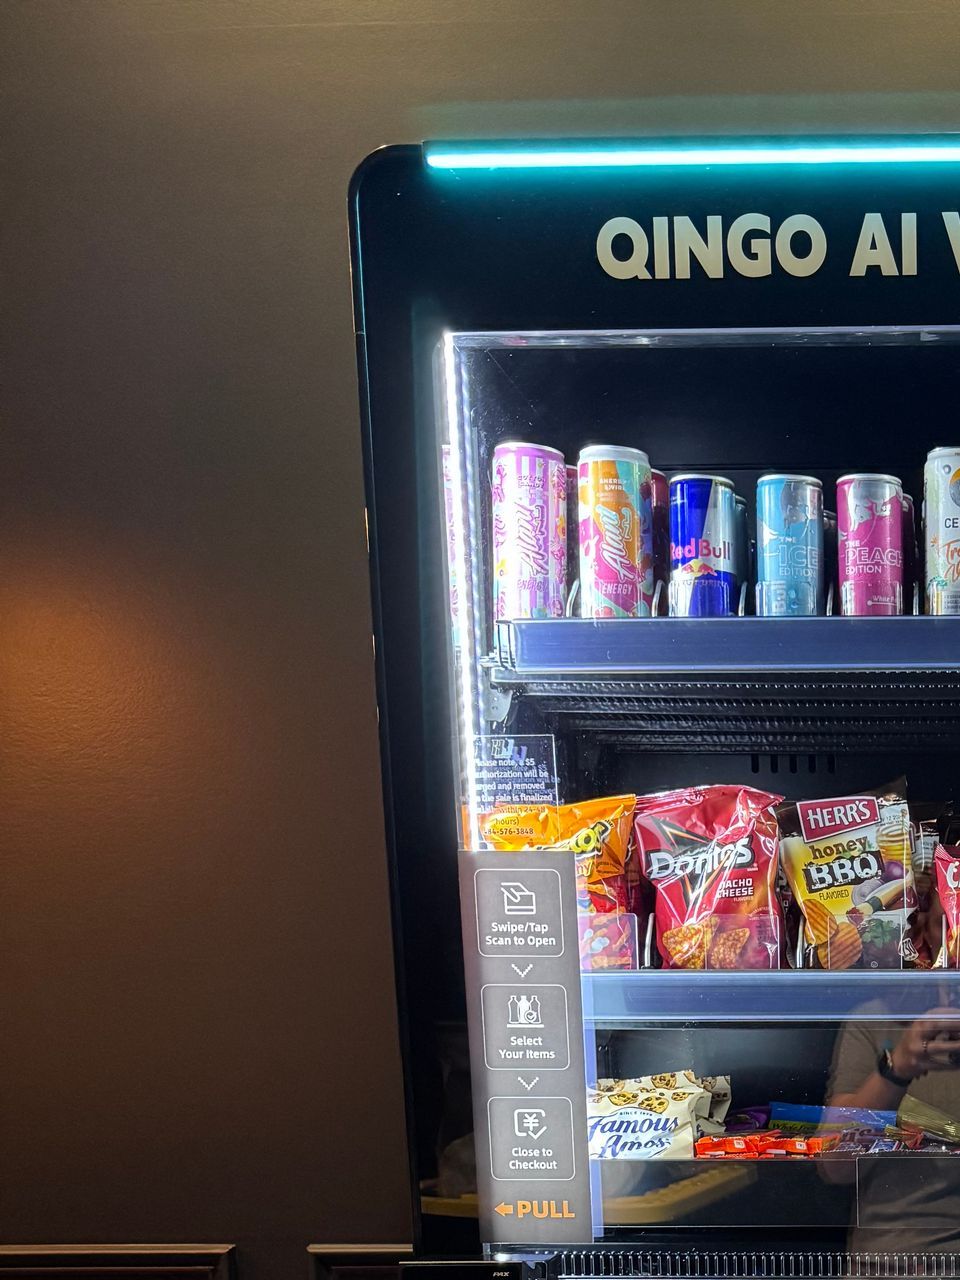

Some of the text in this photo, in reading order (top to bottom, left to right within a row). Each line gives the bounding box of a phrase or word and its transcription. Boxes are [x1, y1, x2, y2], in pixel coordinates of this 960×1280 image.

[597, 213, 827, 281] QINGO
[849, 214, 919, 277] AI
[845, 539, 861, 548] THE
[669, 538, 731, 564] Red Bull
[778, 544, 819, 569] ICE
[778, 566, 817, 577] EDITION
[845, 564, 882, 575] EDITION
[602, 582, 633, 596] ENERGY
[523, 769, 549, 778] will be
[497, 781, 545, 791] and removed
[806, 800, 872, 830] HERR'S
[809, 835, 869, 861] honey
[649, 838, 752, 879] Doritos
[806, 852, 880, 891] BBQ
[818, 889, 850, 901] FLAVORED
[491, 921, 549, 934] Swipe/Tap
[485, 935, 556, 947] Scan to Open
[509, 1035, 543, 1046] Select
[498, 1049, 555, 1060] Your Items
[588, 1115, 679, 1135] Famous
[511, 1147, 553, 1158] Close to
[598, 1135, 670, 1159] Amos
[508, 1159, 558, 1170] Checkout
[516, 1200, 575, 1219] PULL
